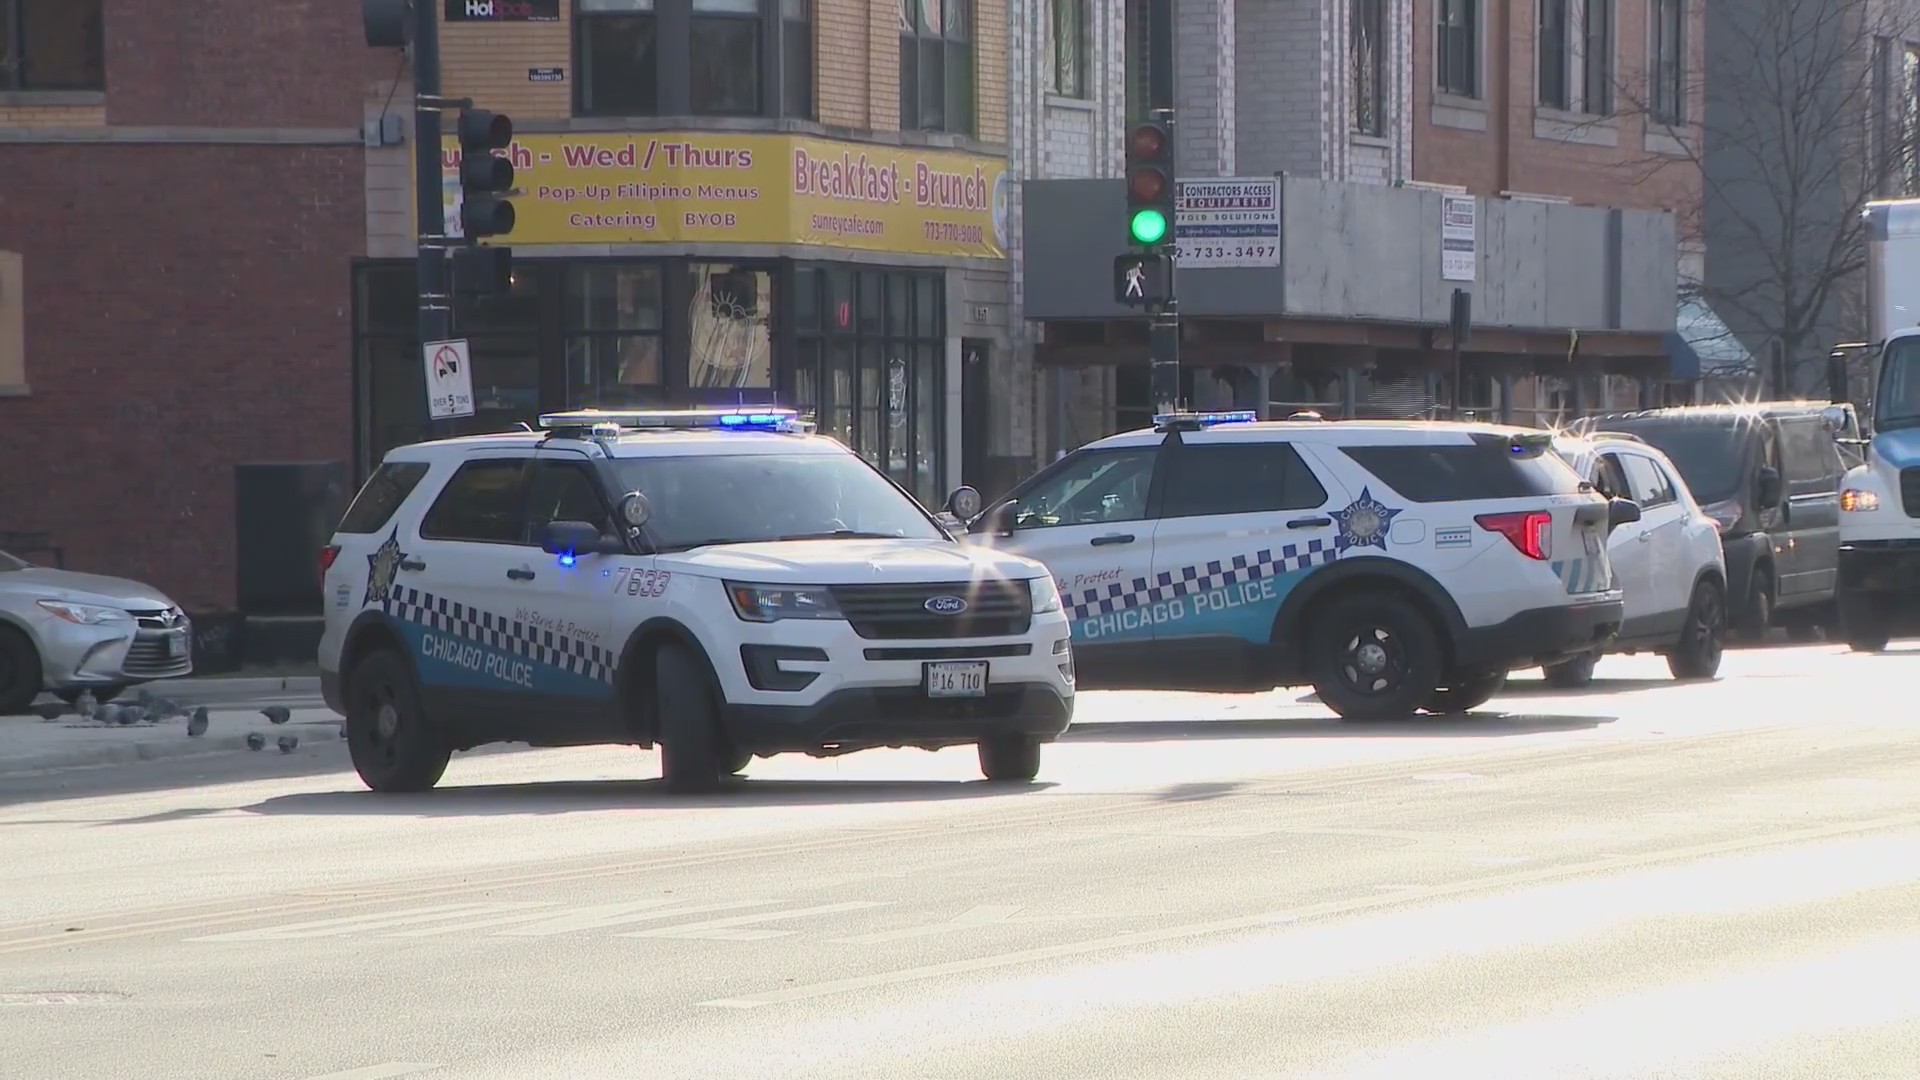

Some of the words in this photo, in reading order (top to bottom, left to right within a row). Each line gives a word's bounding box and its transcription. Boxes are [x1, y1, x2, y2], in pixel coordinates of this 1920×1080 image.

[562, 142, 635, 168] Wed
[662, 142, 753, 168] Thurs
[794, 148, 900, 204] Breakfast
[916, 161, 988, 211] Brunch
[537, 184, 613, 202] Pop-Up
[616, 183, 692, 202] Filipino
[697, 185, 759, 200] Menus
[1185, 186, 1241, 197] CONTRACTORS
[1243, 186, 1271, 196] ACCESS
[569, 211, 656, 229] Catering
[684, 213, 737, 227] BYOB
[812, 213, 884, 236] sunreycafe.com
[1215, 213, 1275, 221] SOLUTIONS
[923, 221, 983, 244] 773-770-9080
[1176, 246, 1276, 258] 2-733-3497
[433, 398, 447, 407] OVER
[448, 394, 455, 407] 5
[456, 395, 469, 404] TONS
[1341, 500, 1388, 521] CHICAGO
[1343, 529, 1386, 546] POLICE
[612, 567, 671, 597] 7633
[1074, 566, 1124, 588] Protect
[936, 598, 959, 611] Ford
[1082, 598, 1185, 640] CHICAGO
[1193, 578, 1276, 617] POLICE
[515, 607, 529, 621] We
[530, 611, 554, 629] Serve
[567, 622, 601, 643] Protect
[421, 633, 482, 671] CHICAGO
[484, 652, 534, 689] POLICE
[940, 673, 954, 690] 16
[960, 672, 980, 690] 710
